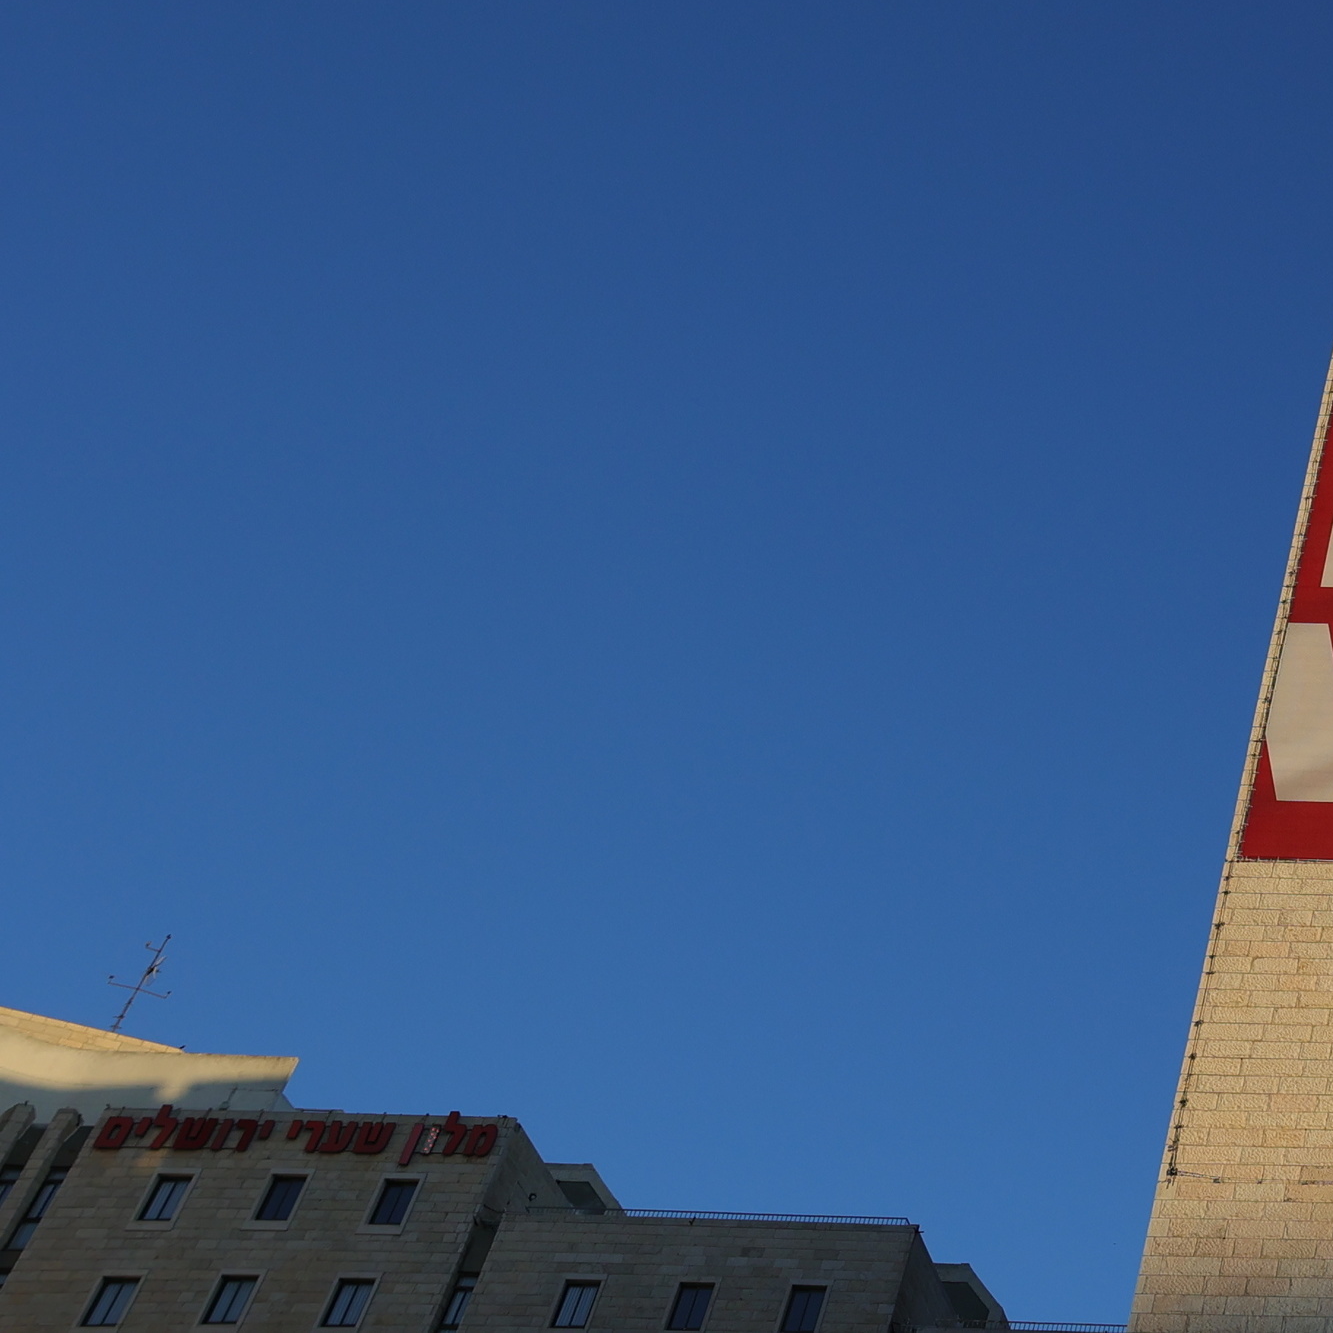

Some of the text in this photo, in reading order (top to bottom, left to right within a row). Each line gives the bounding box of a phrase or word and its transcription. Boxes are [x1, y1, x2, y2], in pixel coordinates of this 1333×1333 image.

[93, 1103, 499, 1166] מלון שערי ירושלים
